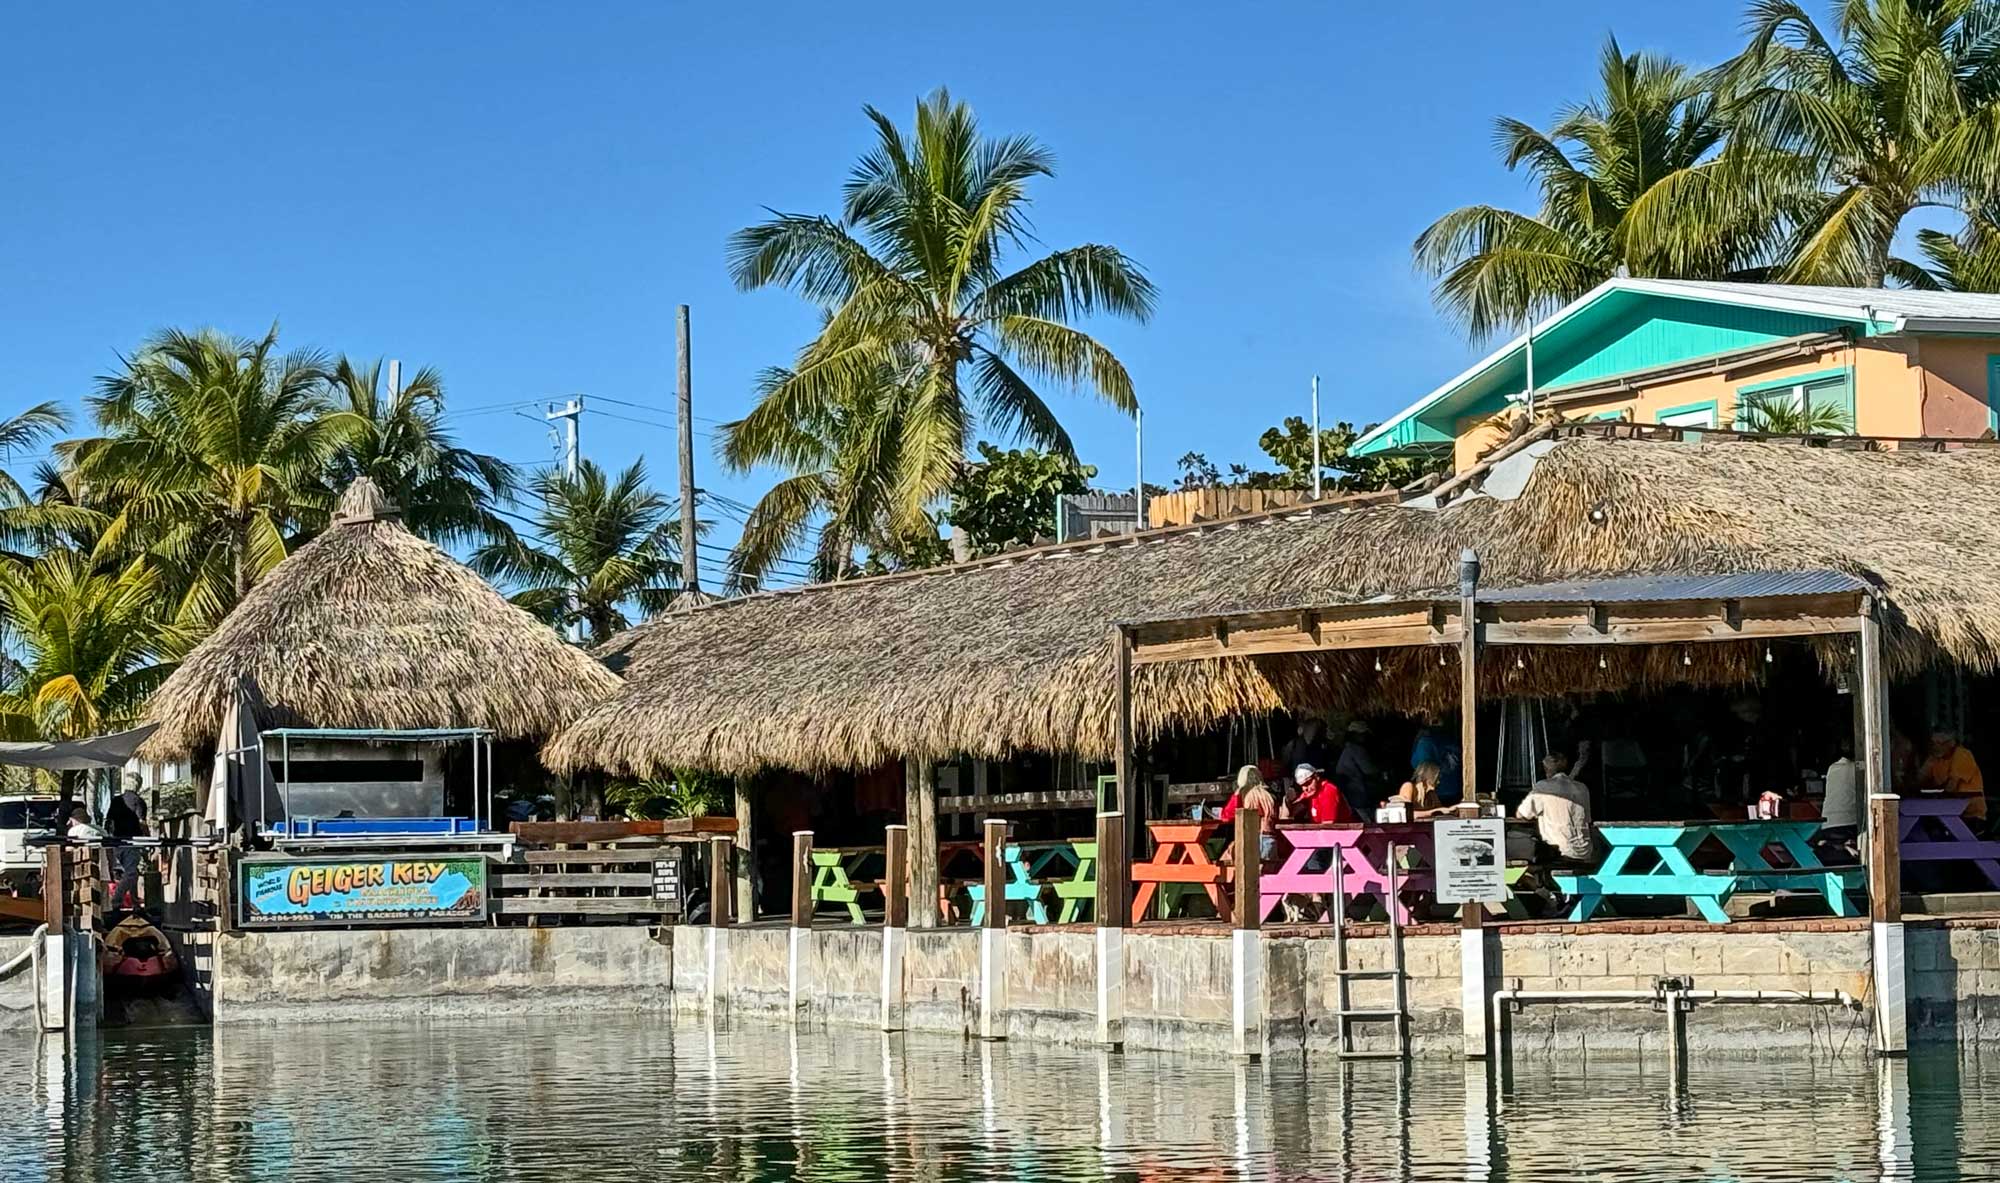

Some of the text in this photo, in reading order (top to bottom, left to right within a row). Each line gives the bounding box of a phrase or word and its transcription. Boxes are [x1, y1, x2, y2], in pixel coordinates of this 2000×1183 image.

[288, 863, 447, 907] GEIGER KEY
[347, 912, 363, 920] THE
[367, 911, 409, 919] BACKSIDE
[413, 910, 425, 918] OF
